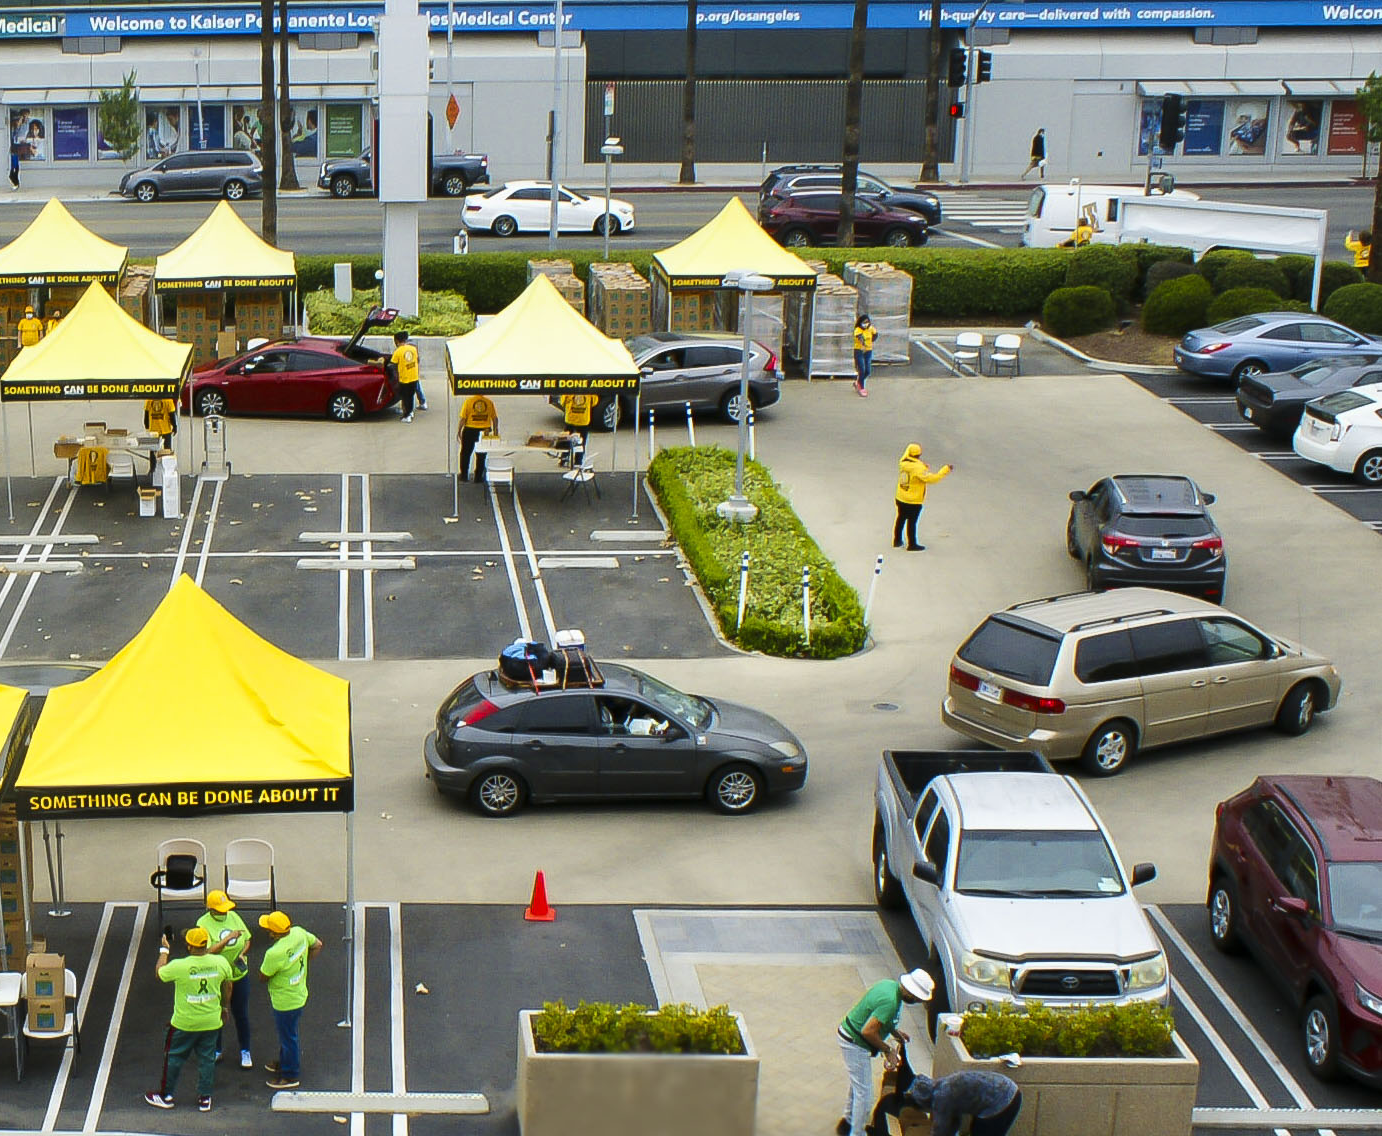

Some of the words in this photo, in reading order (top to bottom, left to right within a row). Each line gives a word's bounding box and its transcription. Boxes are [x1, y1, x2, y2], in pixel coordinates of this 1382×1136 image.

[88, 15, 165, 33] Welcome
[168, 15, 188, 31] to
[190, 13, 244, 31] Kaiser
[451, 9, 513, 26] Medical
[517, 9, 574, 26] Centr
[1101, 8, 1131, 22] with
[1135, 7, 1217, 24] compassion.
[28, 276, 44, 285] CAN
[46, 275, 56, 284] BE
[57, 275, 79, 283] DONE
[108, 273, 116, 282] IT
[157, 282, 203, 290] SOMETHING
[205, 279, 221, 289] CAN
[223, 279, 233, 287] BE
[234, 279, 257, 287] DONE
[259, 278, 285, 287] ABOUT
[286, 278, 294, 287] IT
[672, 279, 720, 288] SOMETHING
[777, 279, 805, 287] ABOUT
[806, 278, 814, 287] IT
[4, 386, 61, 396] SOMETHING
[63, 385, 84, 396] CAN
[86, 384, 98, 394] BE
[101, 383, 127, 394] DONE
[131, 383, 165, 393] ABOUT
[166, 383, 176, 393] IT
[457, 379, 517, 390] SOMETHING
[519, 379, 541, 391] CAN
[543, 379, 556, 389] BE
[558, 379, 588, 389] DONE
[590, 379, 625, 389] ABOUT
[626, 378, 636, 388] IT
[28, 793, 133, 811] SOMETHING
[136, 790, 172, 807] CAN
[176, 789, 199, 805] BE
[203, 788, 254, 805] DONE
[257, 787, 319, 804] ABOUT
[322, 786, 340, 803] IT
